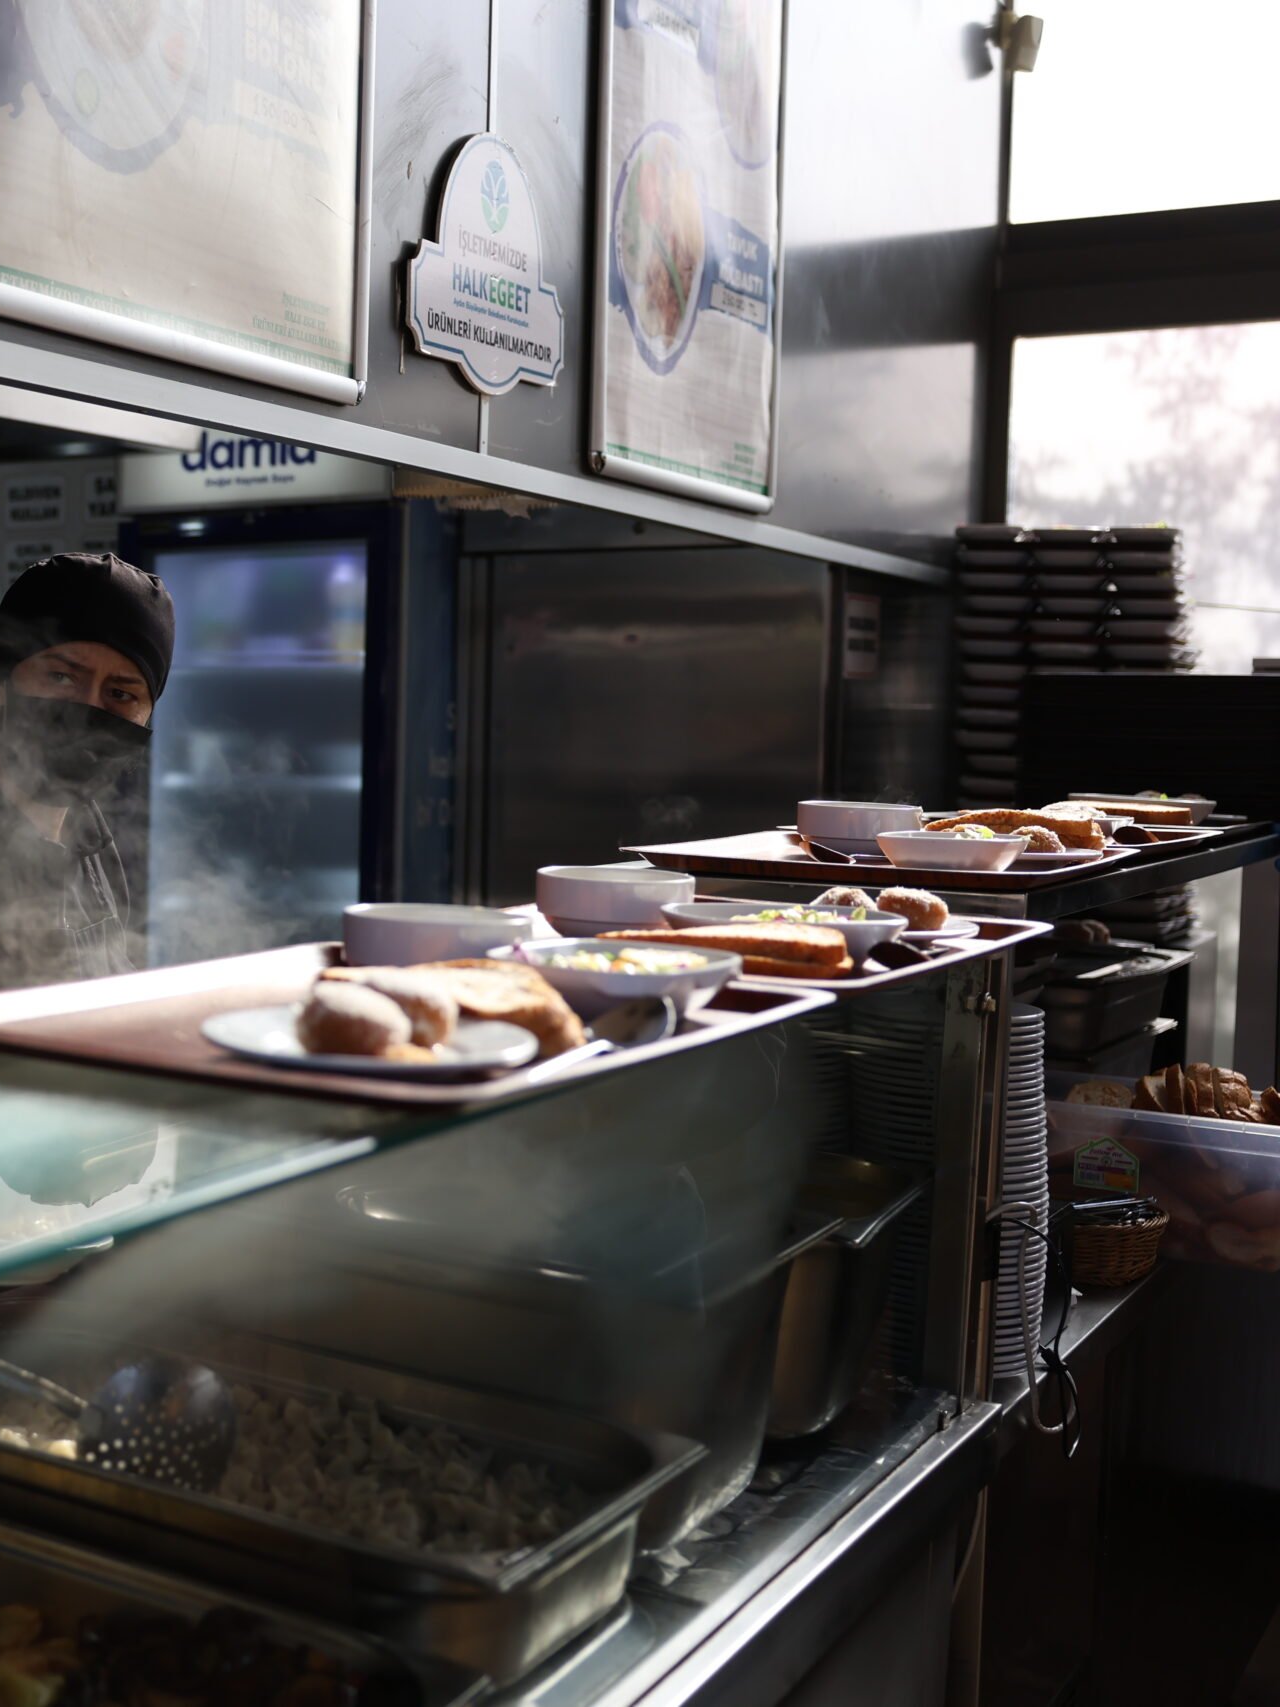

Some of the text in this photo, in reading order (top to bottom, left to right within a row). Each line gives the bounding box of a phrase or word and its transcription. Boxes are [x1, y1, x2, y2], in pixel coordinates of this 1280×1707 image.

[458, 223, 528, 273] İŞLETMEMİZDE
[427, 308, 552, 363] ÜRÜNLERİ KULLANILMAKTADIR
